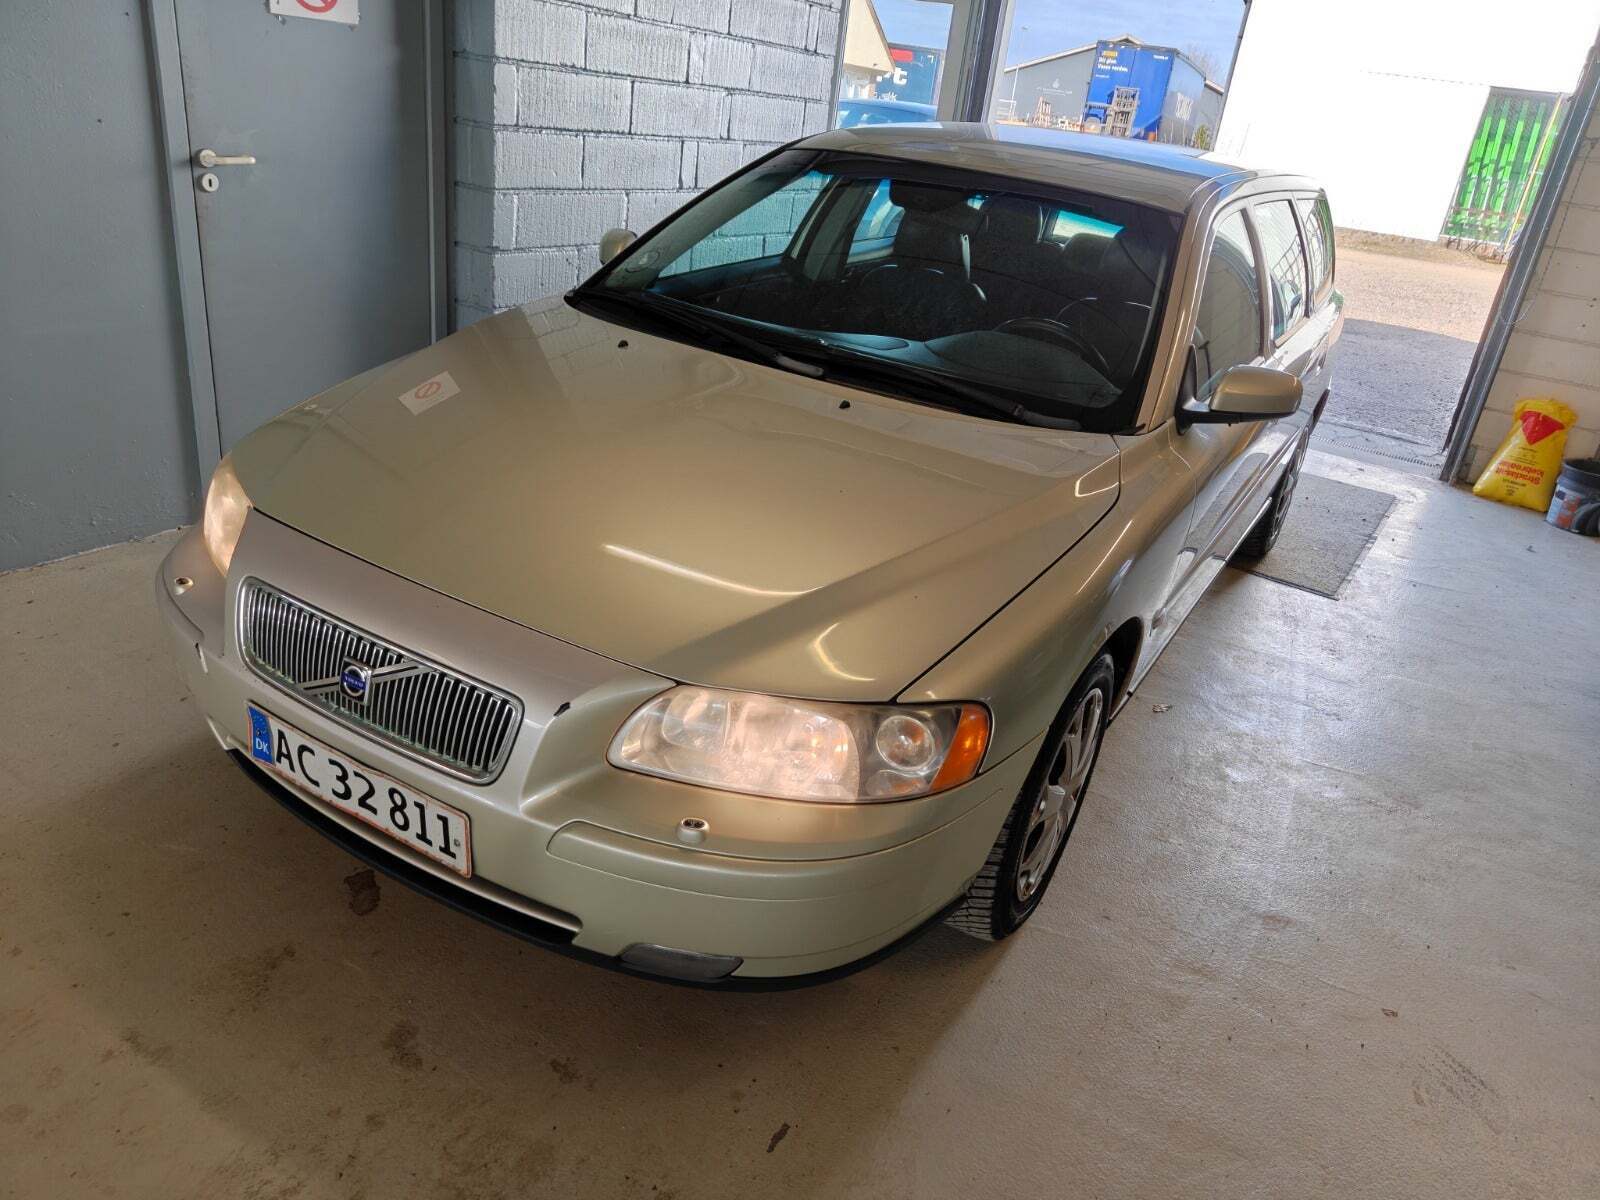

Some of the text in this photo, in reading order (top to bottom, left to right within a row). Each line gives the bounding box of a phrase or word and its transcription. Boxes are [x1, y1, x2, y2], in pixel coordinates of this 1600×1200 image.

[345, 674, 364, 688] VOLVO
[255, 737, 270, 755] DK
[276, 728, 457, 859] AC 32 811
